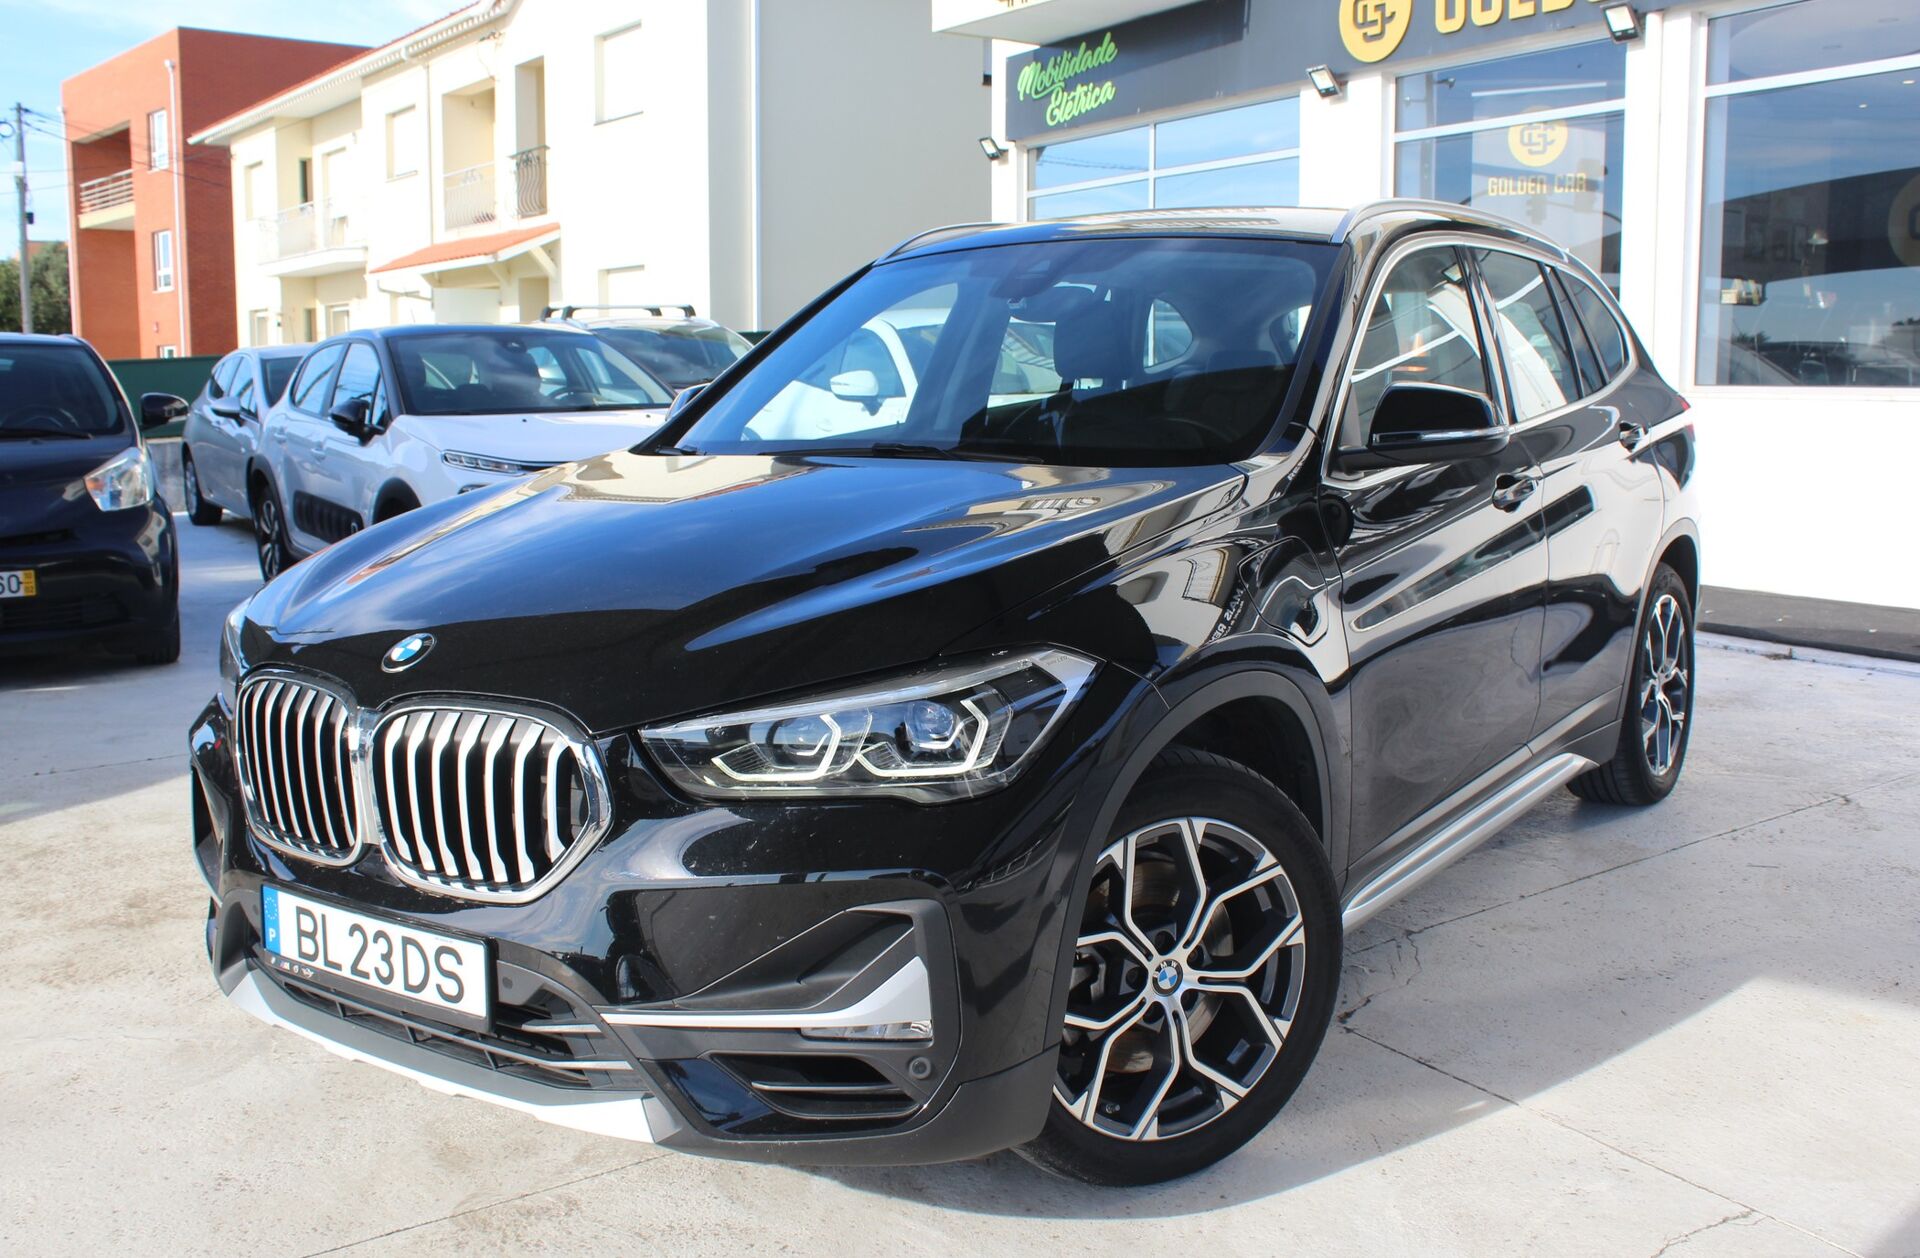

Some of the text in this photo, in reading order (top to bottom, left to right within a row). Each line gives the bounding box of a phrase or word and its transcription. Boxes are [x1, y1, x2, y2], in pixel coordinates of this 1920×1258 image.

[1017, 31, 1118, 101] Mobilidade
[1487, 175, 1547, 196] GOLDEN
[268, 927, 277, 942] P
